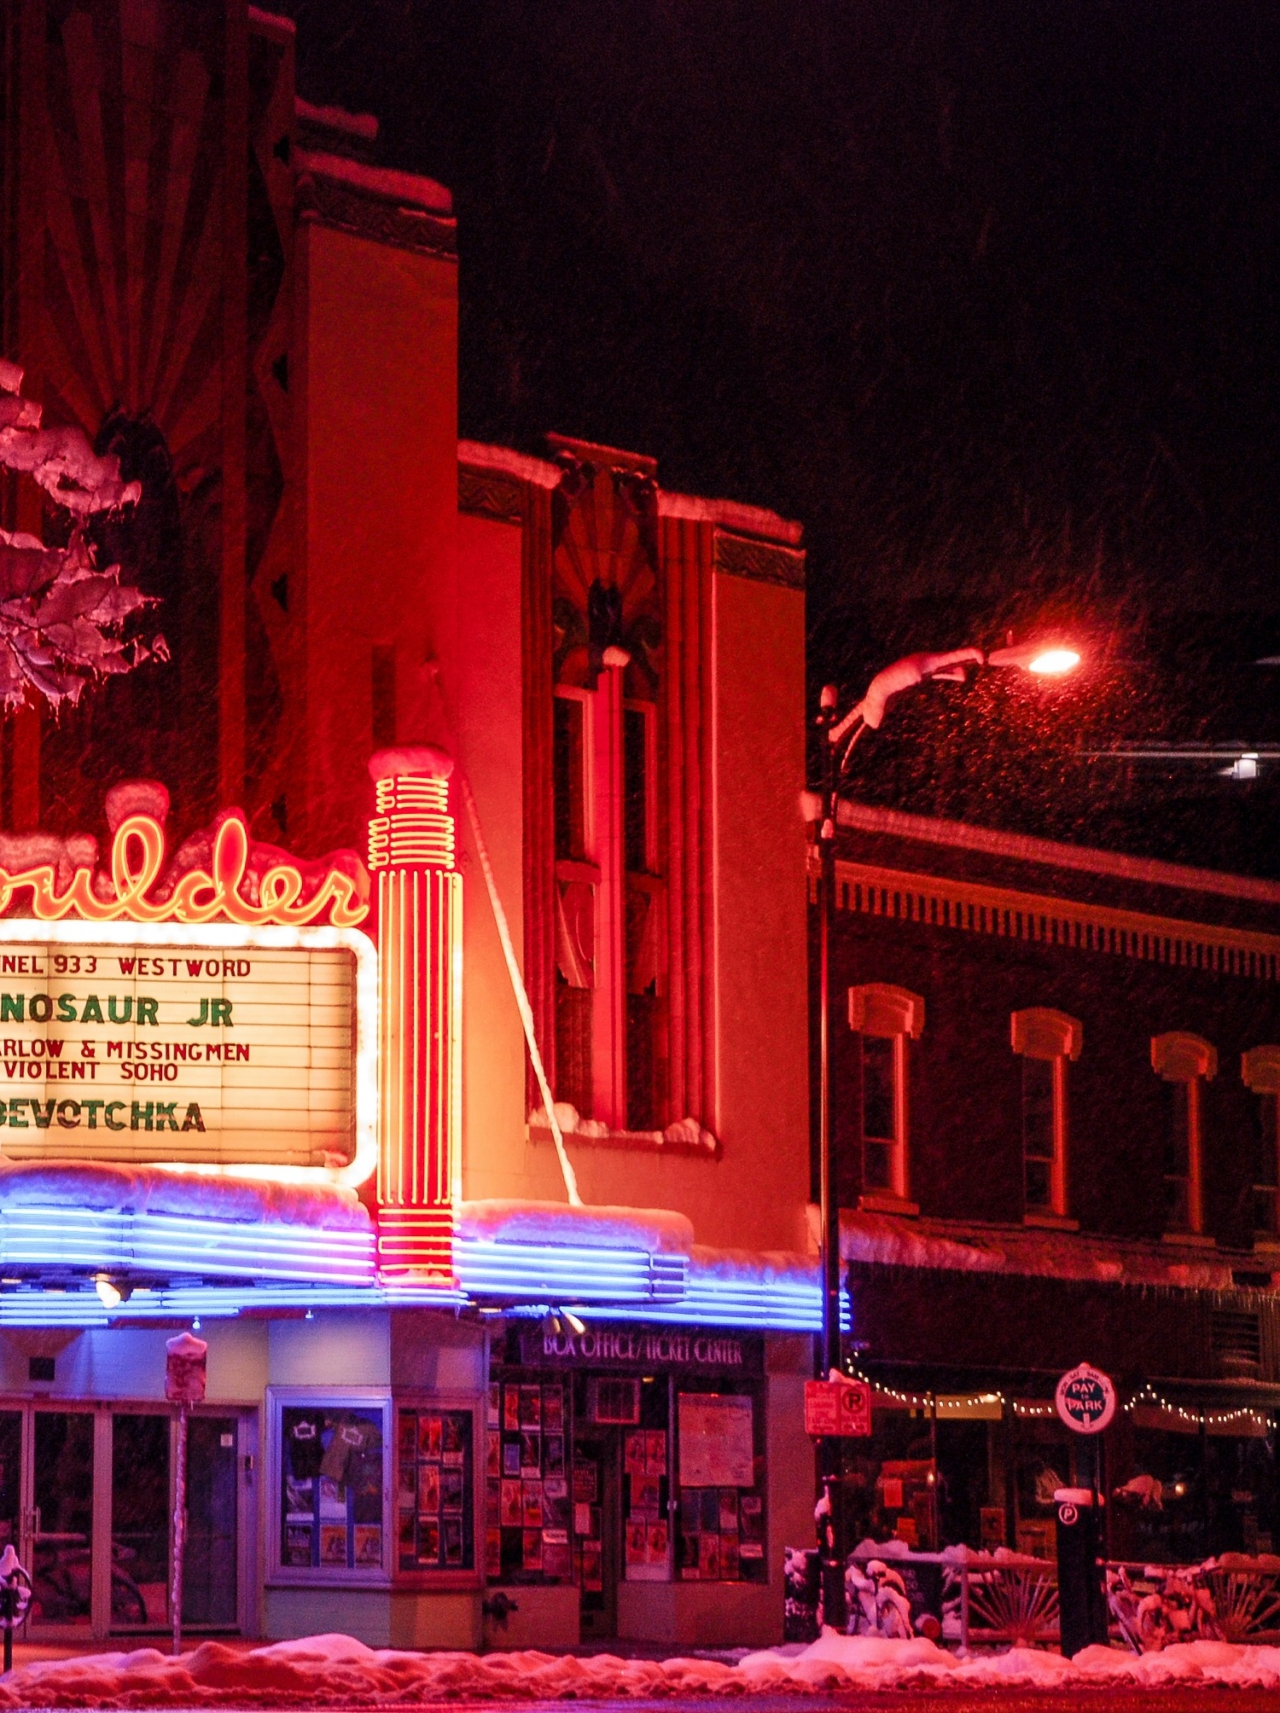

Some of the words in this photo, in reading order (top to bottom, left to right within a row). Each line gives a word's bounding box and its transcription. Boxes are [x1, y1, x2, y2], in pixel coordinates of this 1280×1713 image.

[53, 954, 97, 974] 933
[117, 956, 251, 977] WESTWORD
[186, 997, 233, 1027] JR
[80, 1040, 96, 1058] &
[107, 1040, 250, 1061] MISSINGMEN
[4, 1060, 101, 1080] VIOLENT
[120, 1062, 179, 1081] SOHO
[543, 1333, 575, 1356] BOX
[694, 1338, 743, 1365] CENTER
[1072, 1383, 1095, 1393] PAY
[1067, 1400, 1102, 1411] PARK
